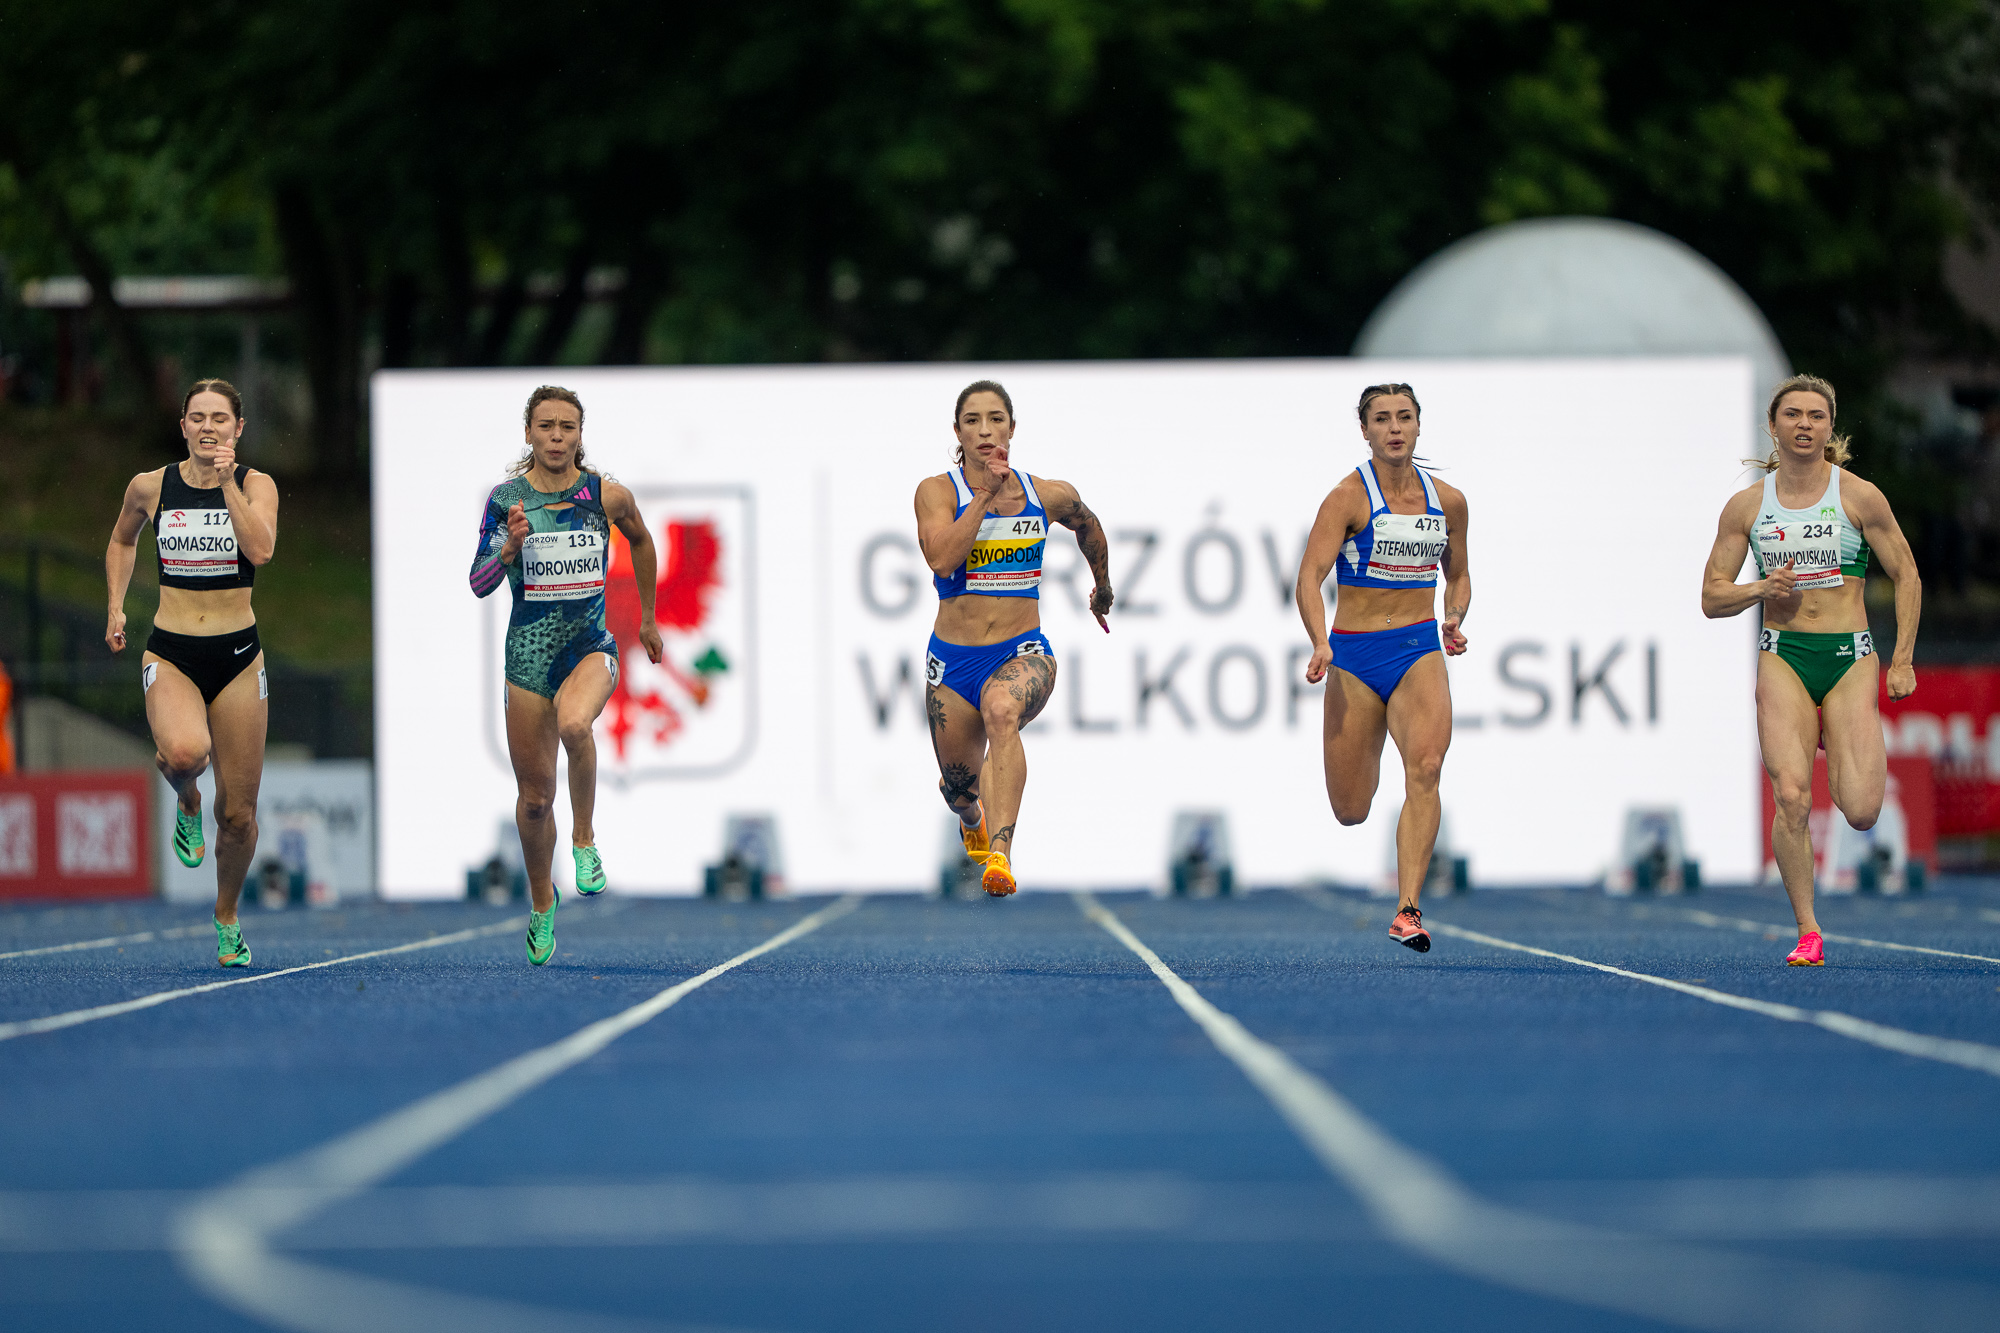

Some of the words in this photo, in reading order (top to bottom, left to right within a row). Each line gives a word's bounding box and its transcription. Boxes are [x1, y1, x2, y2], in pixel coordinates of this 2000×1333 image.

[204, 512, 230, 526] 117
[1012, 520, 1040, 535] 474
[1415, 518, 1440, 532] 473
[523, 535, 559, 545] GORZÓW
[1803, 524, 1833, 539] 234
[160, 536, 235, 552] ROMASZKO
[568, 533, 596, 548] 131
[1375, 540, 1445, 558] STEFANOWICZ
[857, 500, 1342, 620] GRZÓW
[970, 546, 1041, 565] SWOBODA
[526, 557, 600, 576] HOROWSKA
[1370, 569, 1395, 578] GORZÓW
[1761, 630, 1771, 651] 3
[1861, 634, 1872, 657] 3
[144, 664, 152, 687] 7
[927, 657, 940, 680] 5
